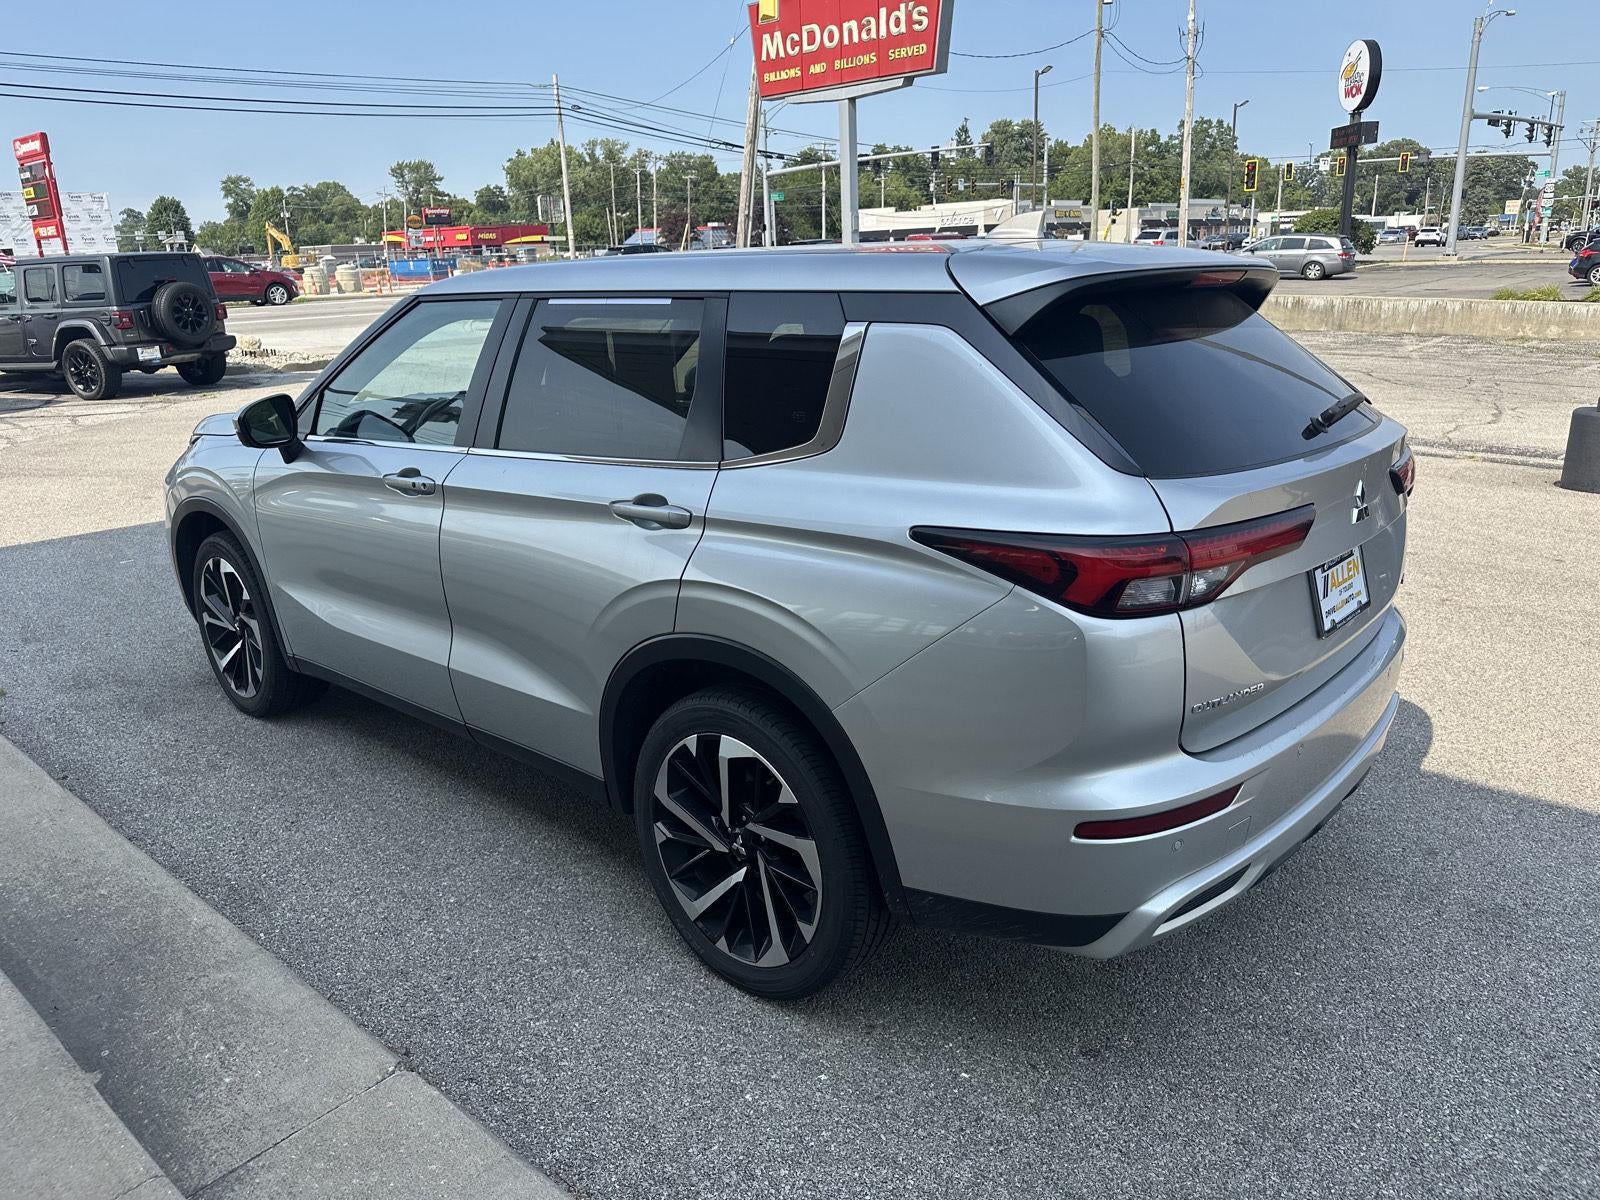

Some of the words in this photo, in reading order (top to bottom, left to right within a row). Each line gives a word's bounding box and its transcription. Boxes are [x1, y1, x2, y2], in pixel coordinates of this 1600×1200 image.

[761, 2, 929, 61] McDonald's
[764, 67, 801, 83] BILLIONS
[809, 62, 827, 75] AND
[834, 52, 877, 71] BILLIONS
[888, 43, 928, 61] SERVED
[1344, 84, 1362, 99] WOK
[1330, 556, 1360, 592] ALLEN
[1191, 682, 1265, 714] OUTLANDER
